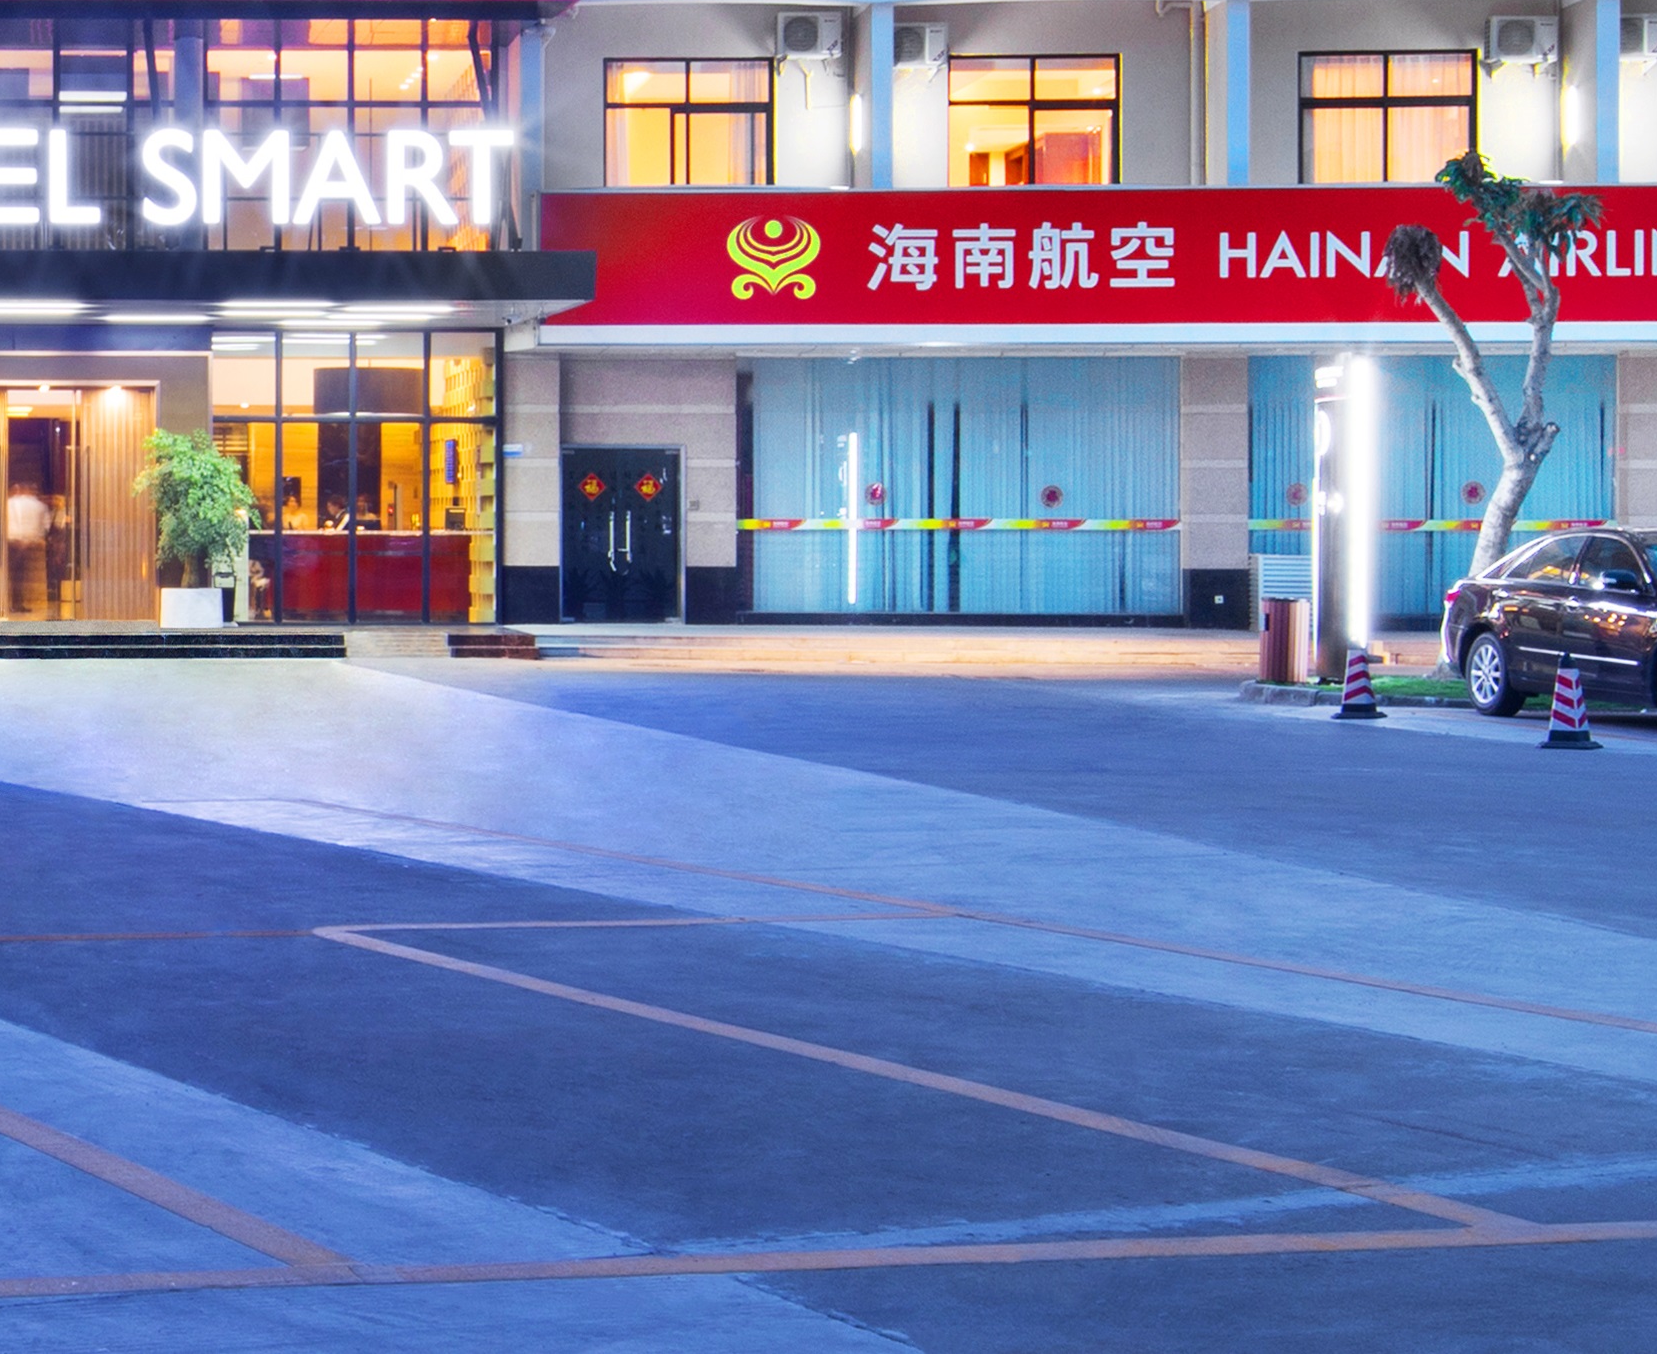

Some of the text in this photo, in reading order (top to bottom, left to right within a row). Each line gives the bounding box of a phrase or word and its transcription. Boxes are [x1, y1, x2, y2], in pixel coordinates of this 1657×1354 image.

[141, 127, 514, 226] SMART
[867, 221, 1176, 291] 海南航空
[1218, 230, 1470, 280] HAINN
